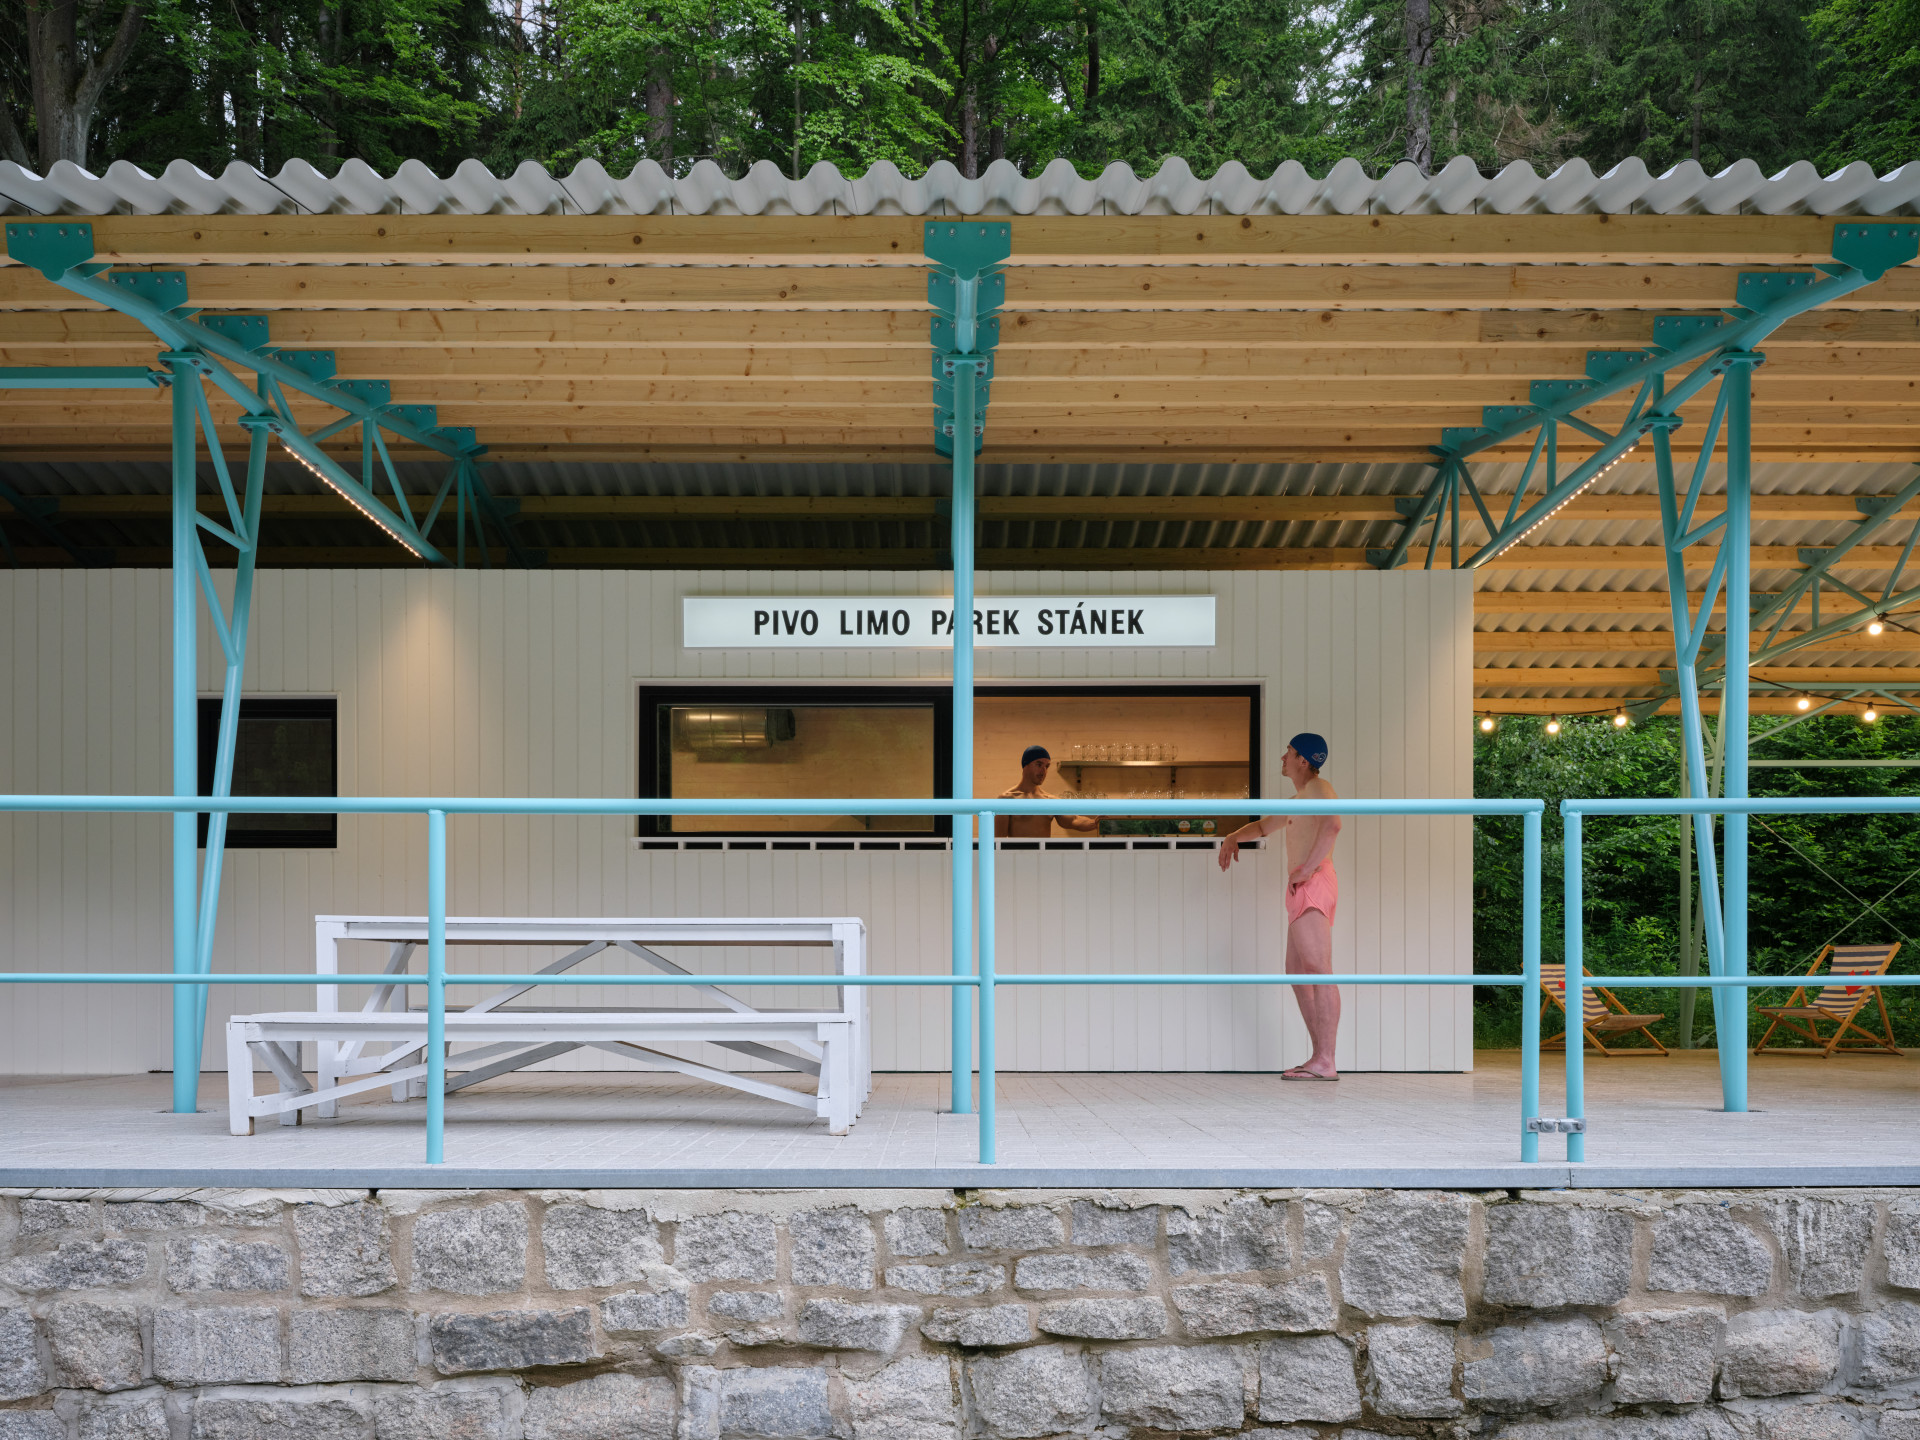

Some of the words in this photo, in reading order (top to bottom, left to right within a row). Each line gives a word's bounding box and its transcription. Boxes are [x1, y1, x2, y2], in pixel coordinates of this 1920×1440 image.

[754, 609, 819, 636] PIVO
[840, 609, 911, 636] LIMO
[1037, 601, 1145, 636] STÁNEK
